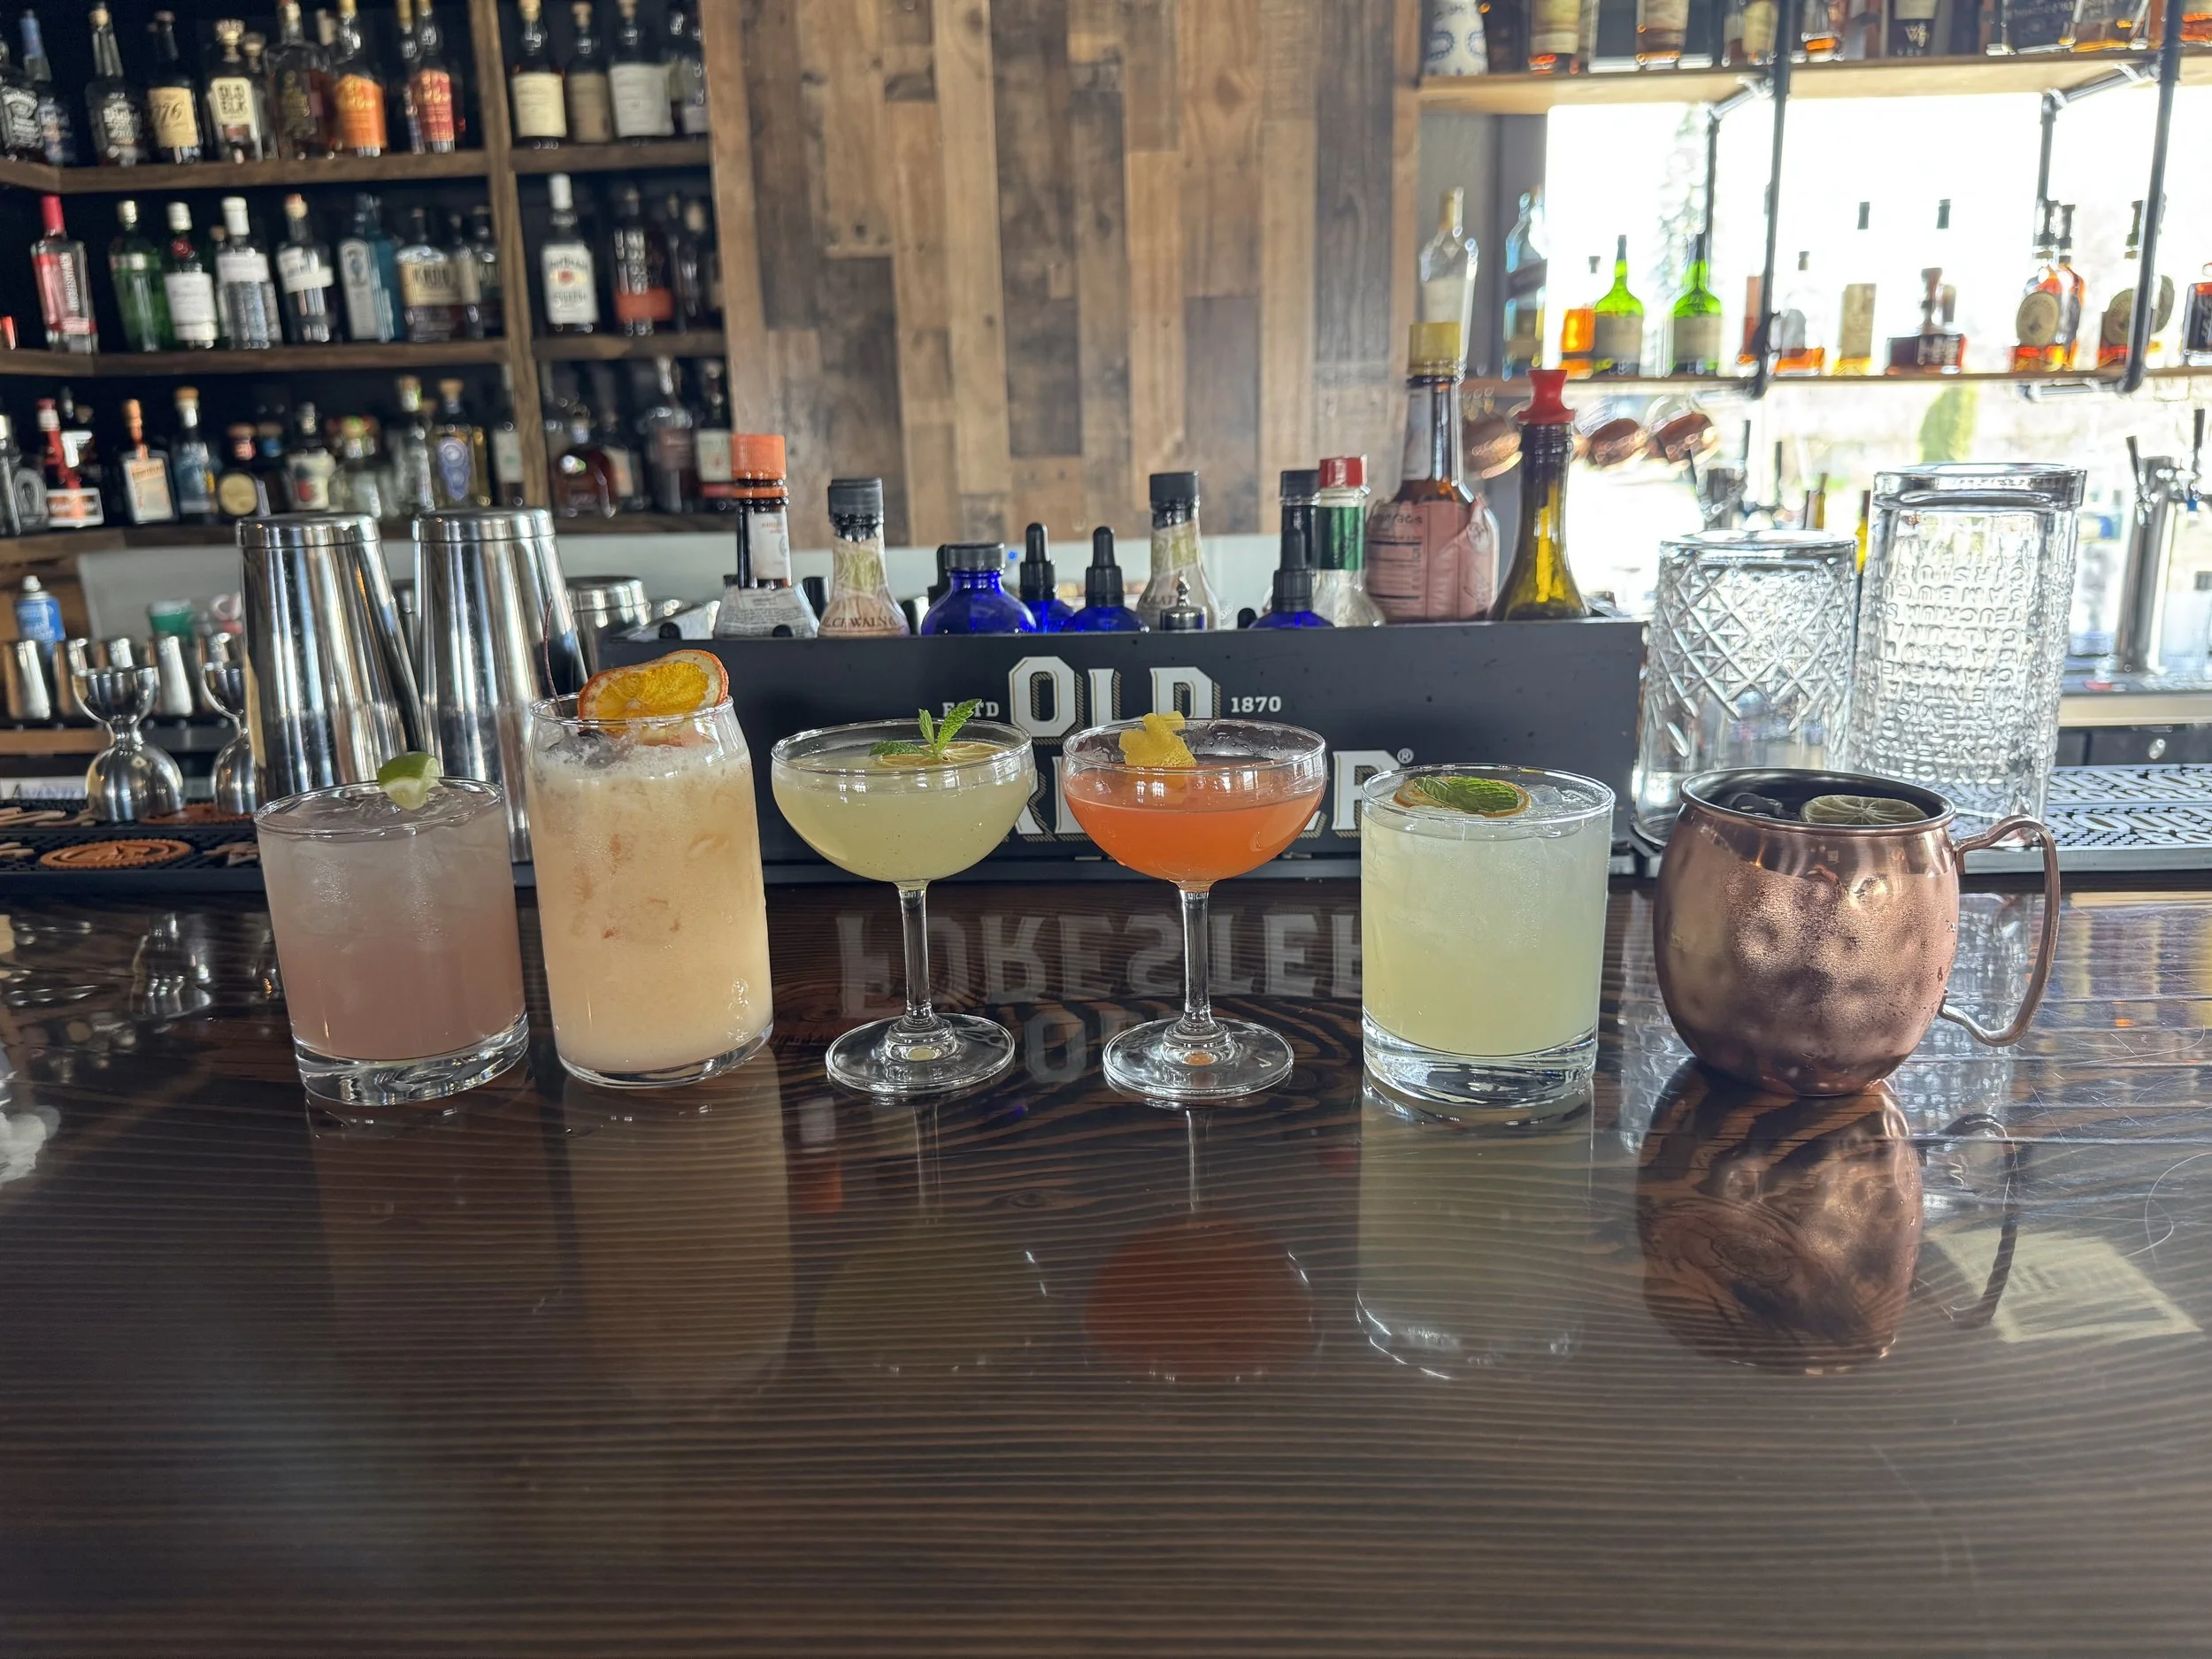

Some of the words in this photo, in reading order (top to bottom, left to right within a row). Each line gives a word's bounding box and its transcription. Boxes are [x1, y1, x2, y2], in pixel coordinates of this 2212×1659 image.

[1008, 656, 1221, 745] OLD
[1231, 695, 1281, 713] 1870
[941, 702, 1000, 718] ETD
